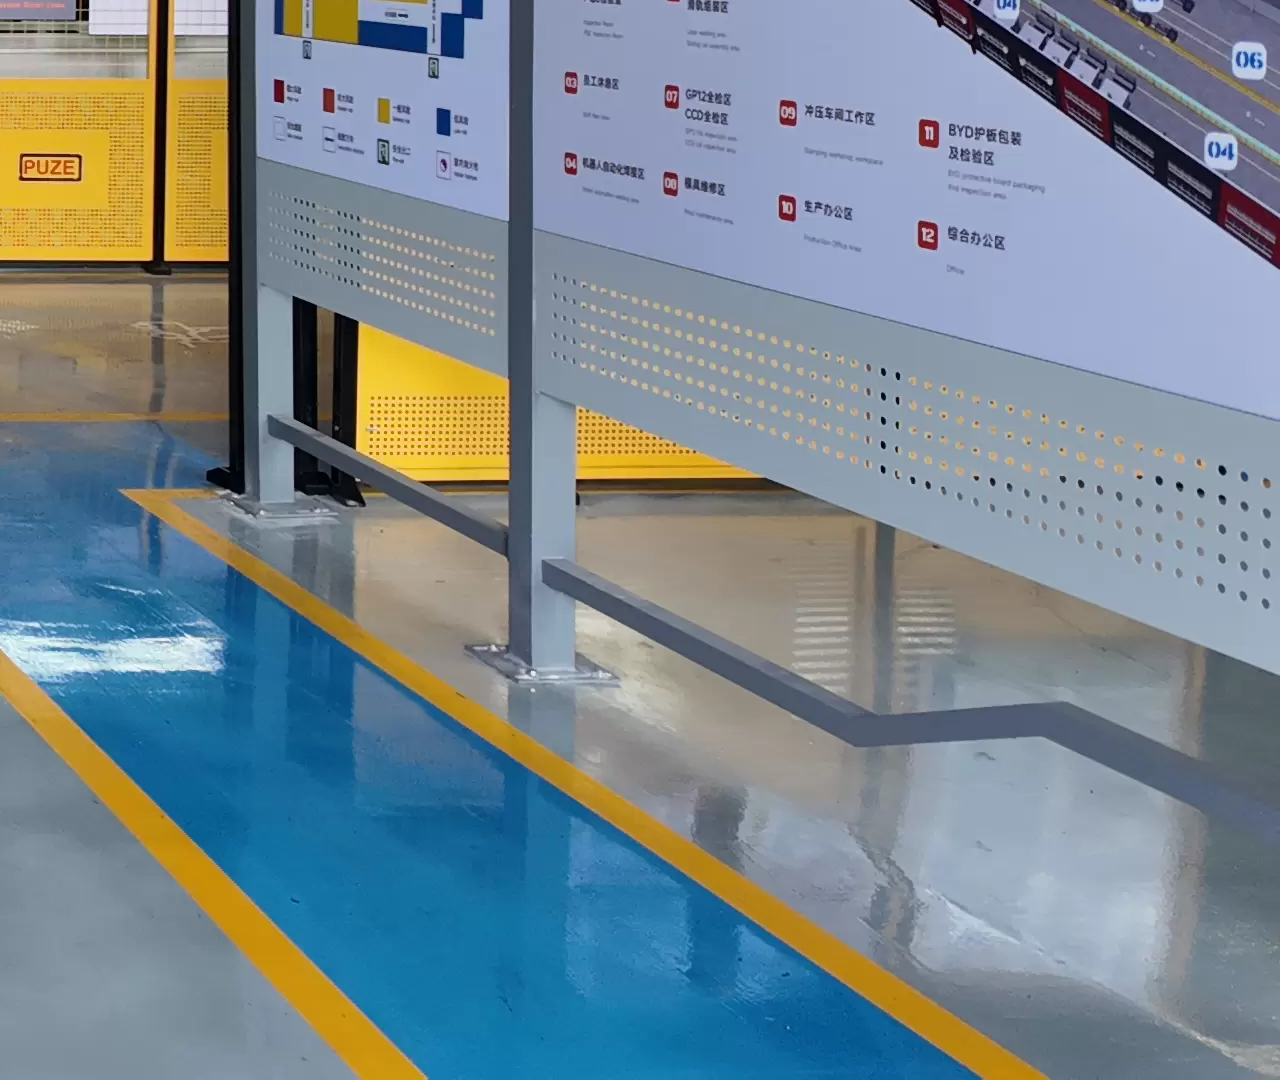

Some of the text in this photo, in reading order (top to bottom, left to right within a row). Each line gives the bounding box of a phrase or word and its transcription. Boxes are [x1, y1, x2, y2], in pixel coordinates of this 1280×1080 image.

[1235, 51, 1264, 69] 06
[566, 76, 577, 89] 03
[665, 90, 678, 104] 07
[780, 105, 796, 120] 09
[804, 104, 876, 126] 冲压车间工作区
[924, 125, 934, 141] 11
[948, 123, 1022, 146] BYD护板包装
[948, 145, 995, 166] 及检验区
[1207, 141, 1235, 161] 04
[24, 159, 76, 176] PUZE
[565, 157, 577, 170] 04
[781, 200, 794, 215] 10
[804, 200, 853, 221] 生产办公区
[921, 227, 935, 243] 12
[947, 226, 1006, 251] 综合办公区
